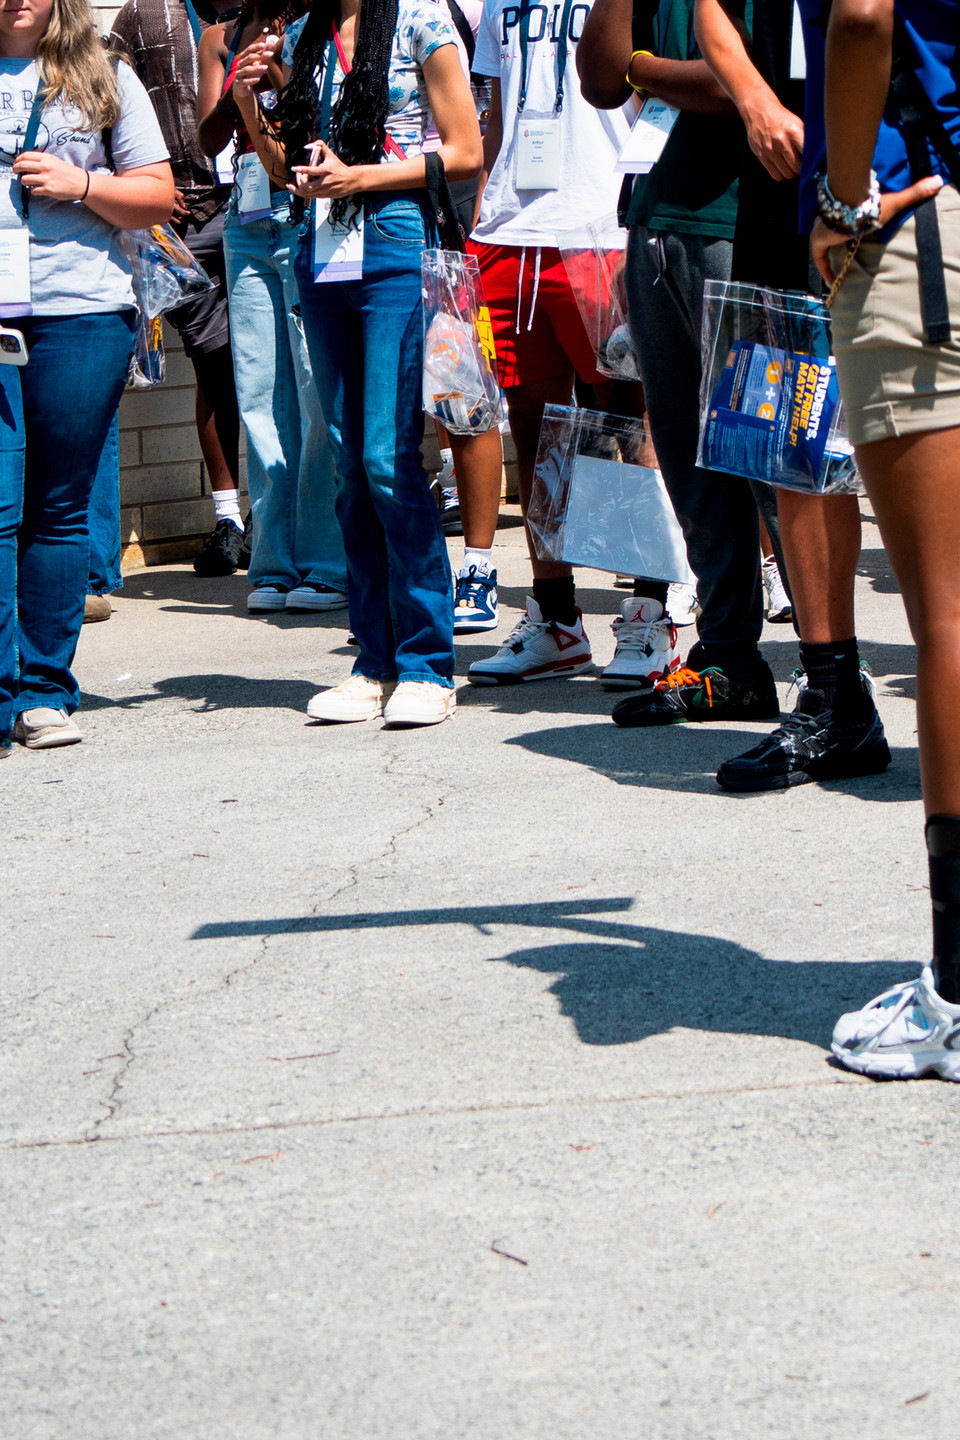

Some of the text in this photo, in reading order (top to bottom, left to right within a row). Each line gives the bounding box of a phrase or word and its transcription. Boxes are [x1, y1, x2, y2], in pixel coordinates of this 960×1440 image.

[501, 3, 591, 46] POLO
[788, 361, 809, 447] MATH HELP!
[799, 363, 820, 430] GET FREE
[805, 365, 832, 441] STUDENTS,
